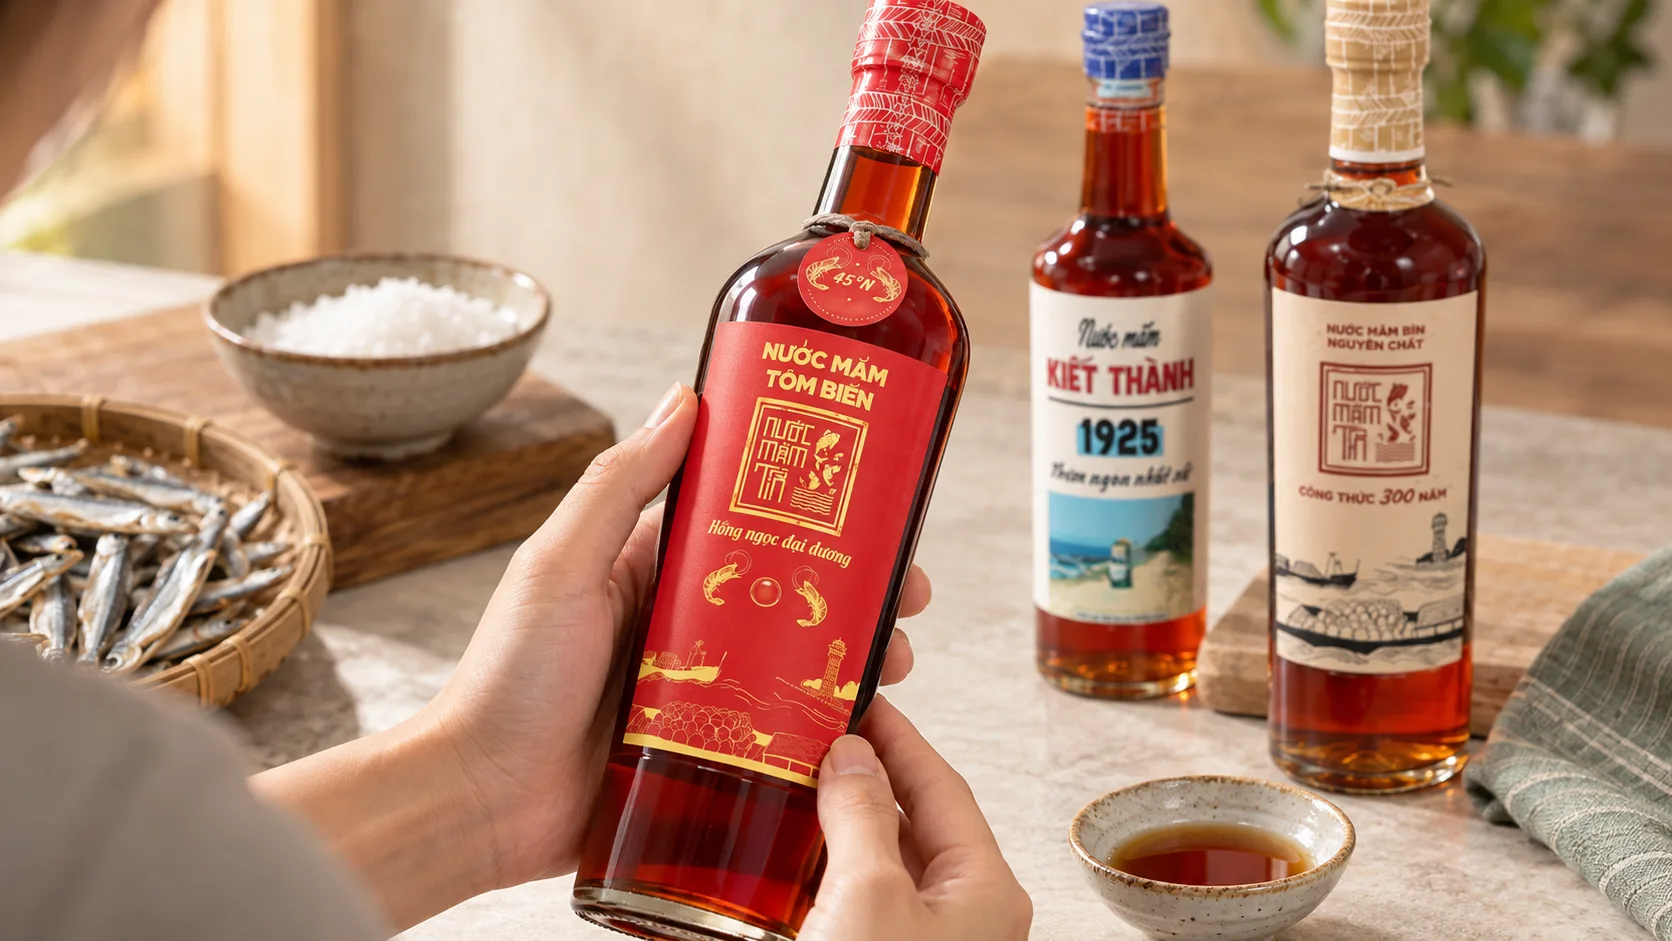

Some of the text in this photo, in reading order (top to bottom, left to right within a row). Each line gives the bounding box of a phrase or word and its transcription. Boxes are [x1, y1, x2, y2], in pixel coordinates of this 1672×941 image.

[833, 272, 876, 291] 45°N
[762, 339, 828, 369] NƯỚC
[766, 369, 818, 396] TÔM
[1047, 355, 1195, 396] KIẾT THÀNH
[1081, 418, 1159, 456] 1925
[1088, 472, 1132, 493] ngon
[1379, 488, 1416, 506] 300
[744, 529, 780, 547] ngọc
[781, 534, 808, 554] đại
[808, 541, 852, 569] dương
